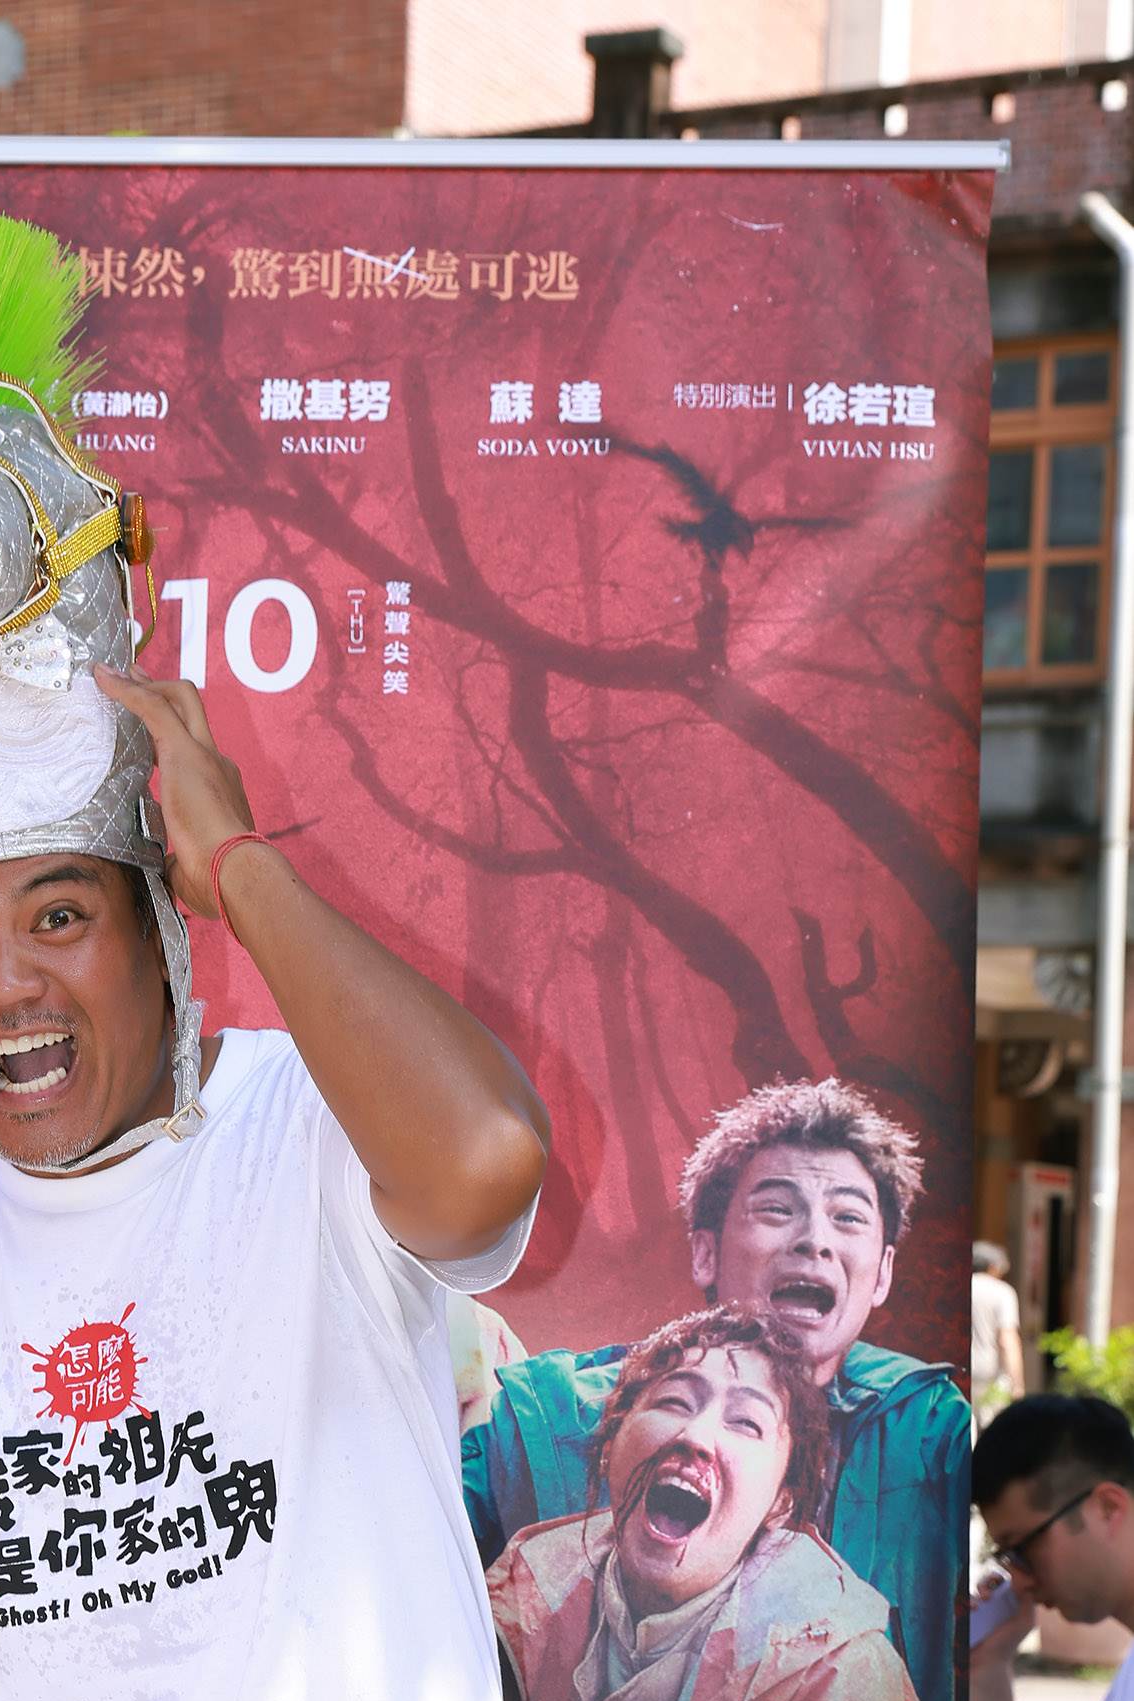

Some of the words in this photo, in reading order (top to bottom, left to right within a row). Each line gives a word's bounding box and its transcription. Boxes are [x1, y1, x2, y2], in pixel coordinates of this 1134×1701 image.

[259, 378, 392, 423] 撒基努
[673, 382, 777, 409] 特別演出
[802, 381, 937, 428] 徐若瑄
[281, 436, 366, 455] SAKINU
[477, 438, 539, 457] SODA
[546, 438, 611, 457] VOYU
[802, 439, 883, 459] VIVIAN
[890, 441, 936, 461] HSU
[382, 580, 413, 695] 驚聲尖笑
[81, 1588, 113, 1613] Oh
[118, 1580, 157, 1604] My
[165, 1554, 224, 1590] God!
